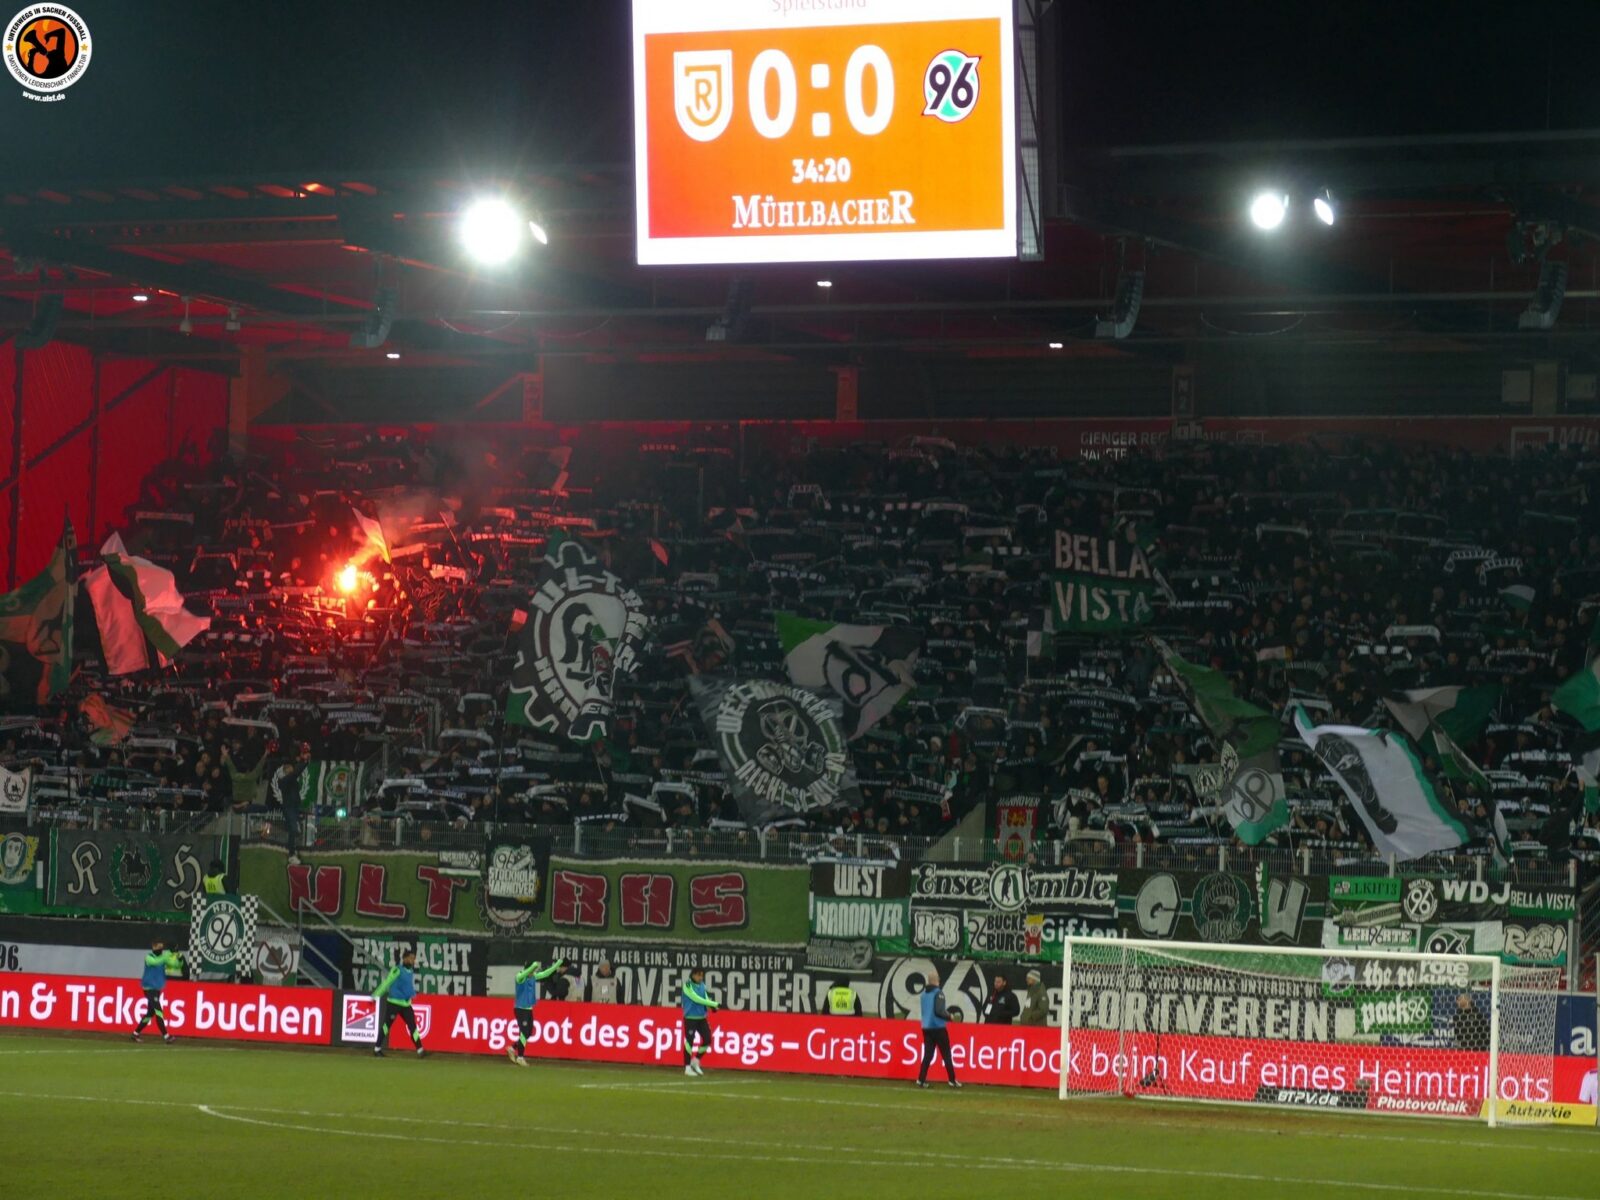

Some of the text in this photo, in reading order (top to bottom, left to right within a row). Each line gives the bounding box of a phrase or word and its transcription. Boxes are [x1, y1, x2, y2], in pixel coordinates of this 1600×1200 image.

[928, 62, 974, 111] 96
[791, 157, 851, 184] 34:20
[1054, 529, 1151, 579] BELLA
[1054, 580, 1151, 622] VISTA
[488, 867, 538, 882] STOCKHOLM
[833, 864, 885, 898] WEST
[212, 903, 235, 913] HSV
[1510, 889, 1576, 911] BELLA VISTA
[211, 916, 235, 951] 96
[552, 946, 579, 961] ABER
[613, 950, 641, 965] ABER
[644, 951, 672, 967] EINS,
[676, 952, 698, 968] DAS
[702, 953, 737, 969] BLEIBT
[741, 955, 794, 971] BESTEH'N
[352, 967, 472, 997] VEECKE!
[29, 983, 57, 1021] &
[194, 991, 323, 1036] buchen
[365, 1016, 374, 1029] 2
[1046, 987, 1329, 1043] SPORTVEREIN
[1360, 992, 1410, 1033] pack
[579, 1015, 630, 1046] des
[637, 1018, 775, 1065] Spitags
[806, 1027, 892, 1066] Gratis
[901, 1033, 1081, 1076] Selerflock
[1091, 1043, 1168, 1082] beim
[1180, 1047, 1253, 1085] Kauf
[1260, 1055, 1347, 1092] eines
[1376, 1094, 1468, 1115] Photovoltaik
[1505, 1101, 1572, 1120] Autarkie
